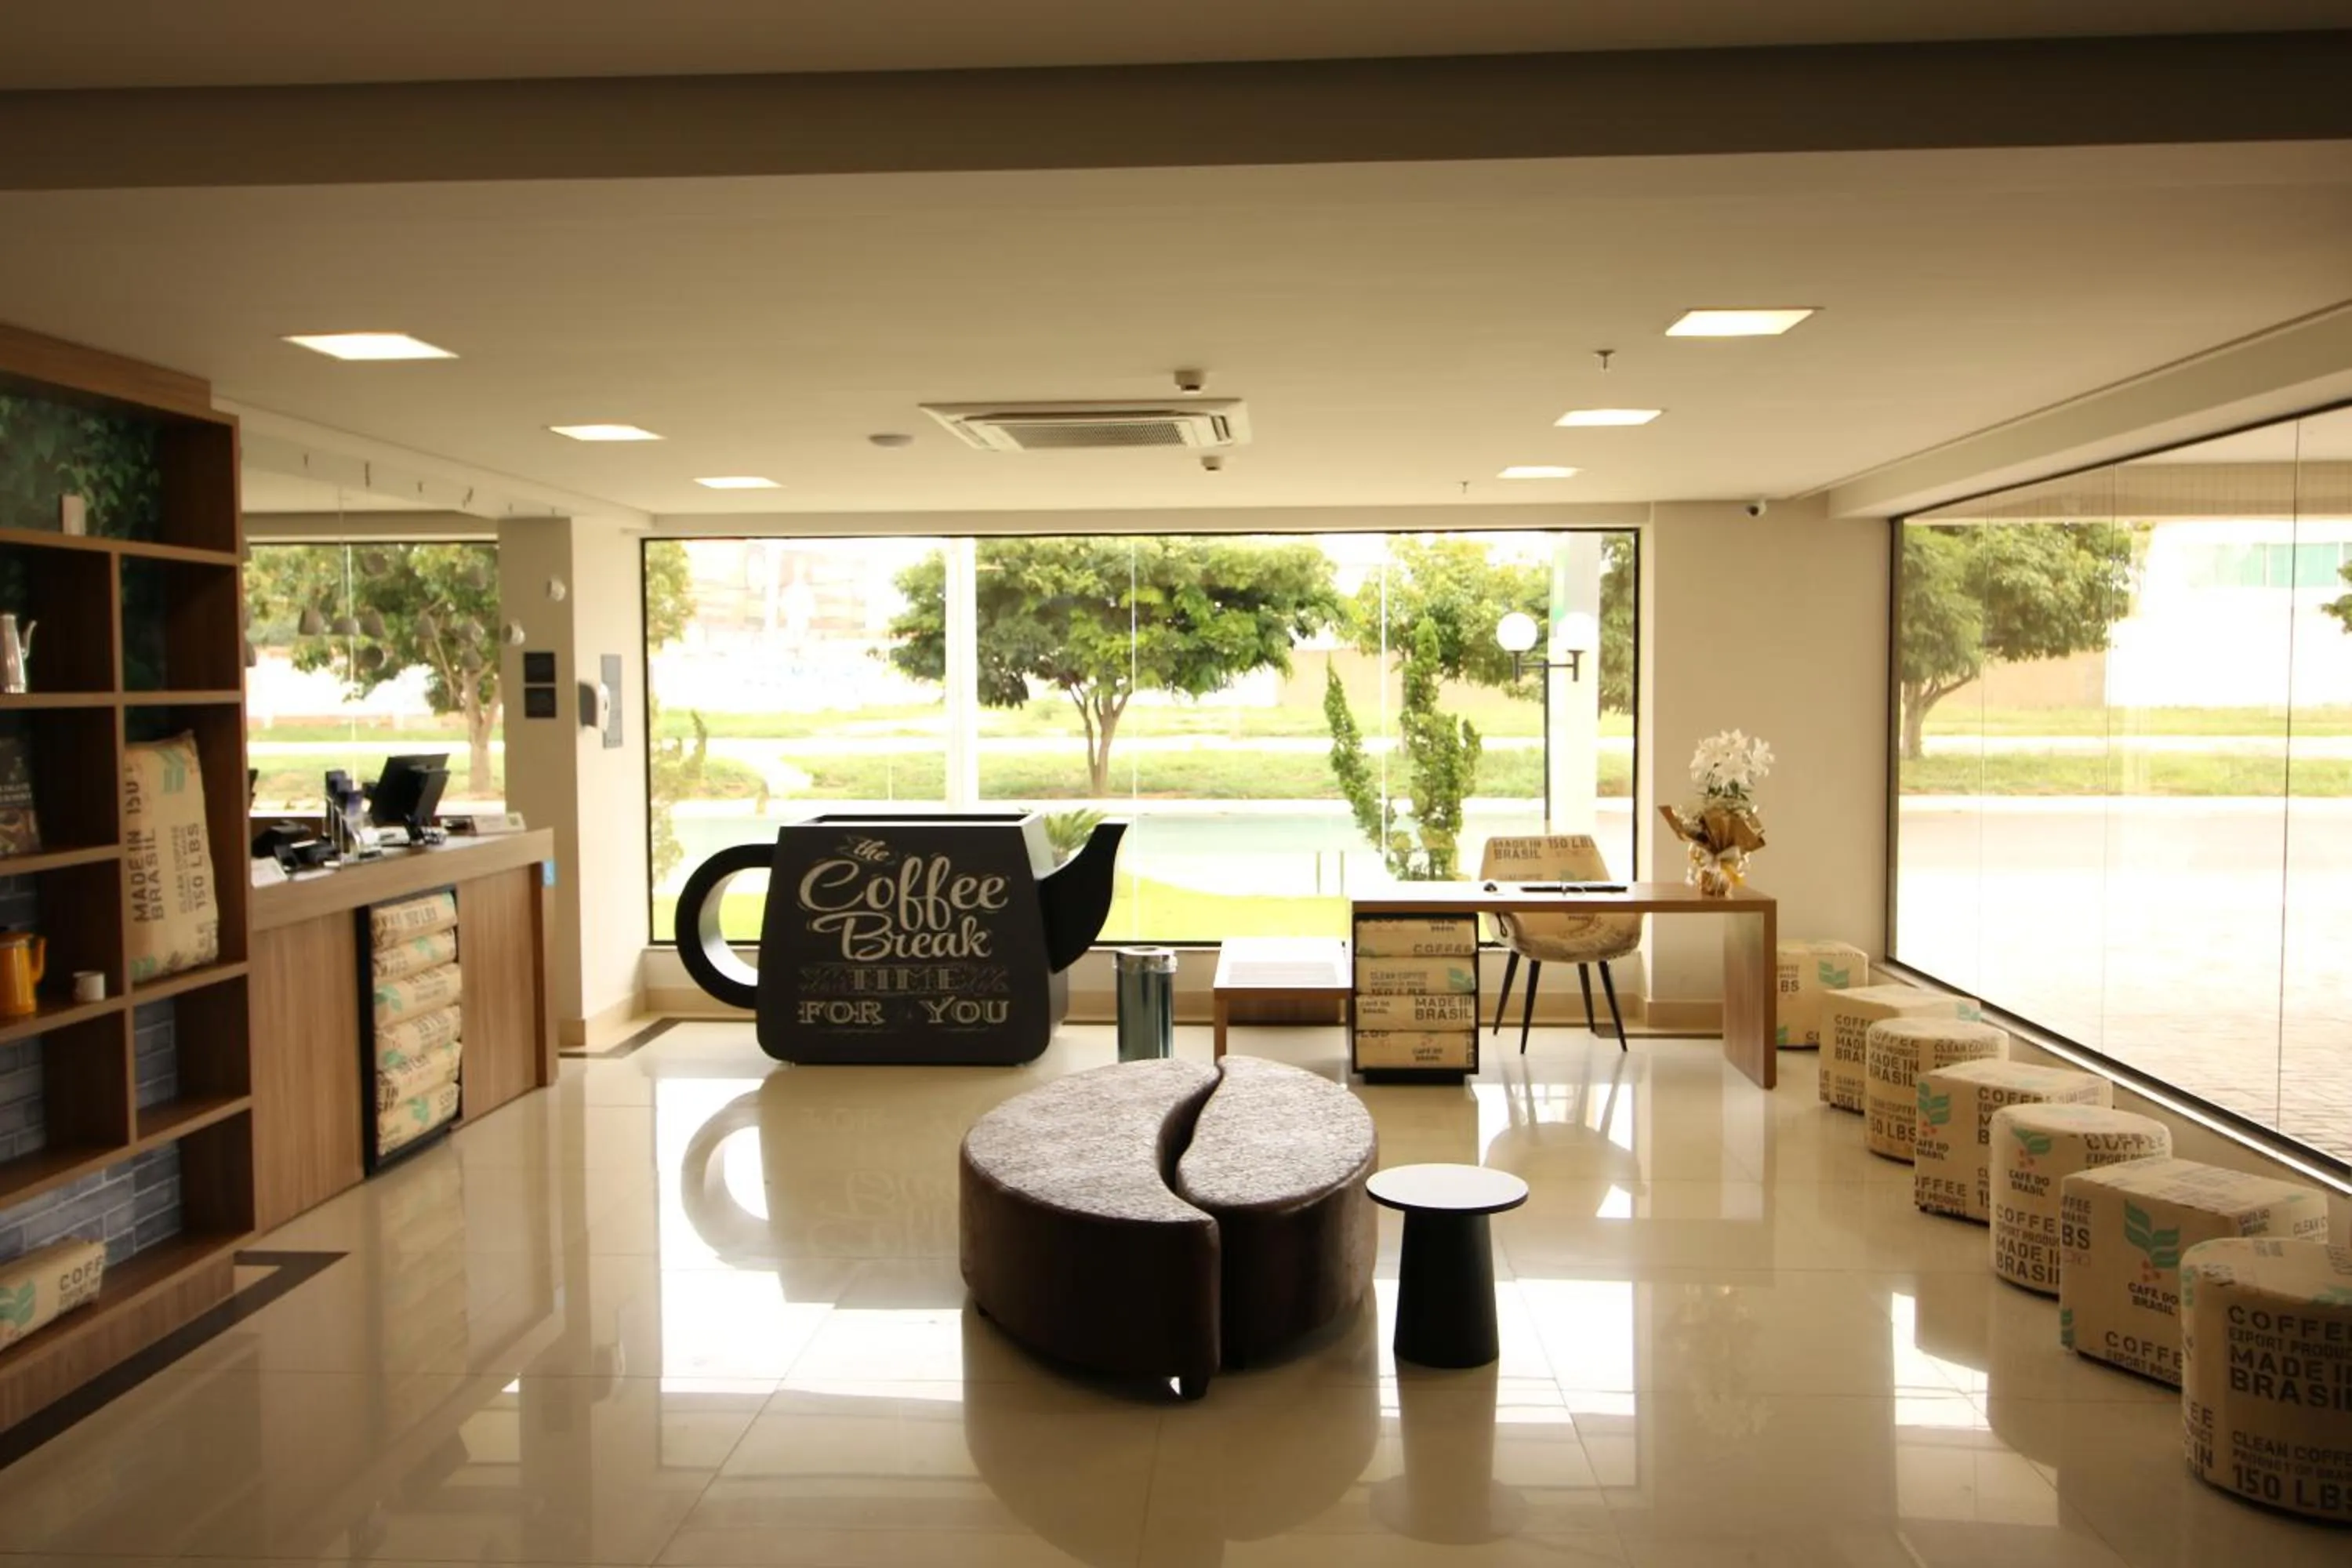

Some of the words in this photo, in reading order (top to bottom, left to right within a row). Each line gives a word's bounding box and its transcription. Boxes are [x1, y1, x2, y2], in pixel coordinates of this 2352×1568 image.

[127, 830, 143, 855] IN
[187, 823, 203, 869] LBS
[853, 837, 890, 862] the
[1493, 840, 1526, 849] MADE
[1494, 848, 1543, 860] BRASIL
[1548, 837, 1569, 849] 150
[144, 828, 164, 920] BRASIL
[127, 858, 149, 924] MADE
[193, 876, 209, 909] 150
[798, 855, 1009, 933] Coffee
[811, 910, 992, 961] Break
[850, 968, 965, 991] TIME
[798, 1000, 884, 1025] FOR
[920, 996, 1010, 1025] YOU
[1414, 996, 1457, 1008] MADE
[1414, 1007, 1473, 1021] BRASIL
[1903, 1058, 1920, 1073] IN
[1887, 1121, 1917, 1144] LBS
[2011, 1179, 2045, 1198] BRASIL
[2034, 1174, 2051, 1188] DO
[1996, 1233, 2043, 1263] MADE
[2131, 1294, 2176, 1318] BRASIL
[2161, 1291, 2180, 1305] DO
[2230, 1343, 2325, 1383] MADE
[2232, 1429, 2288, 1459] CLEAN
[2232, 1463, 2282, 1501] 150
